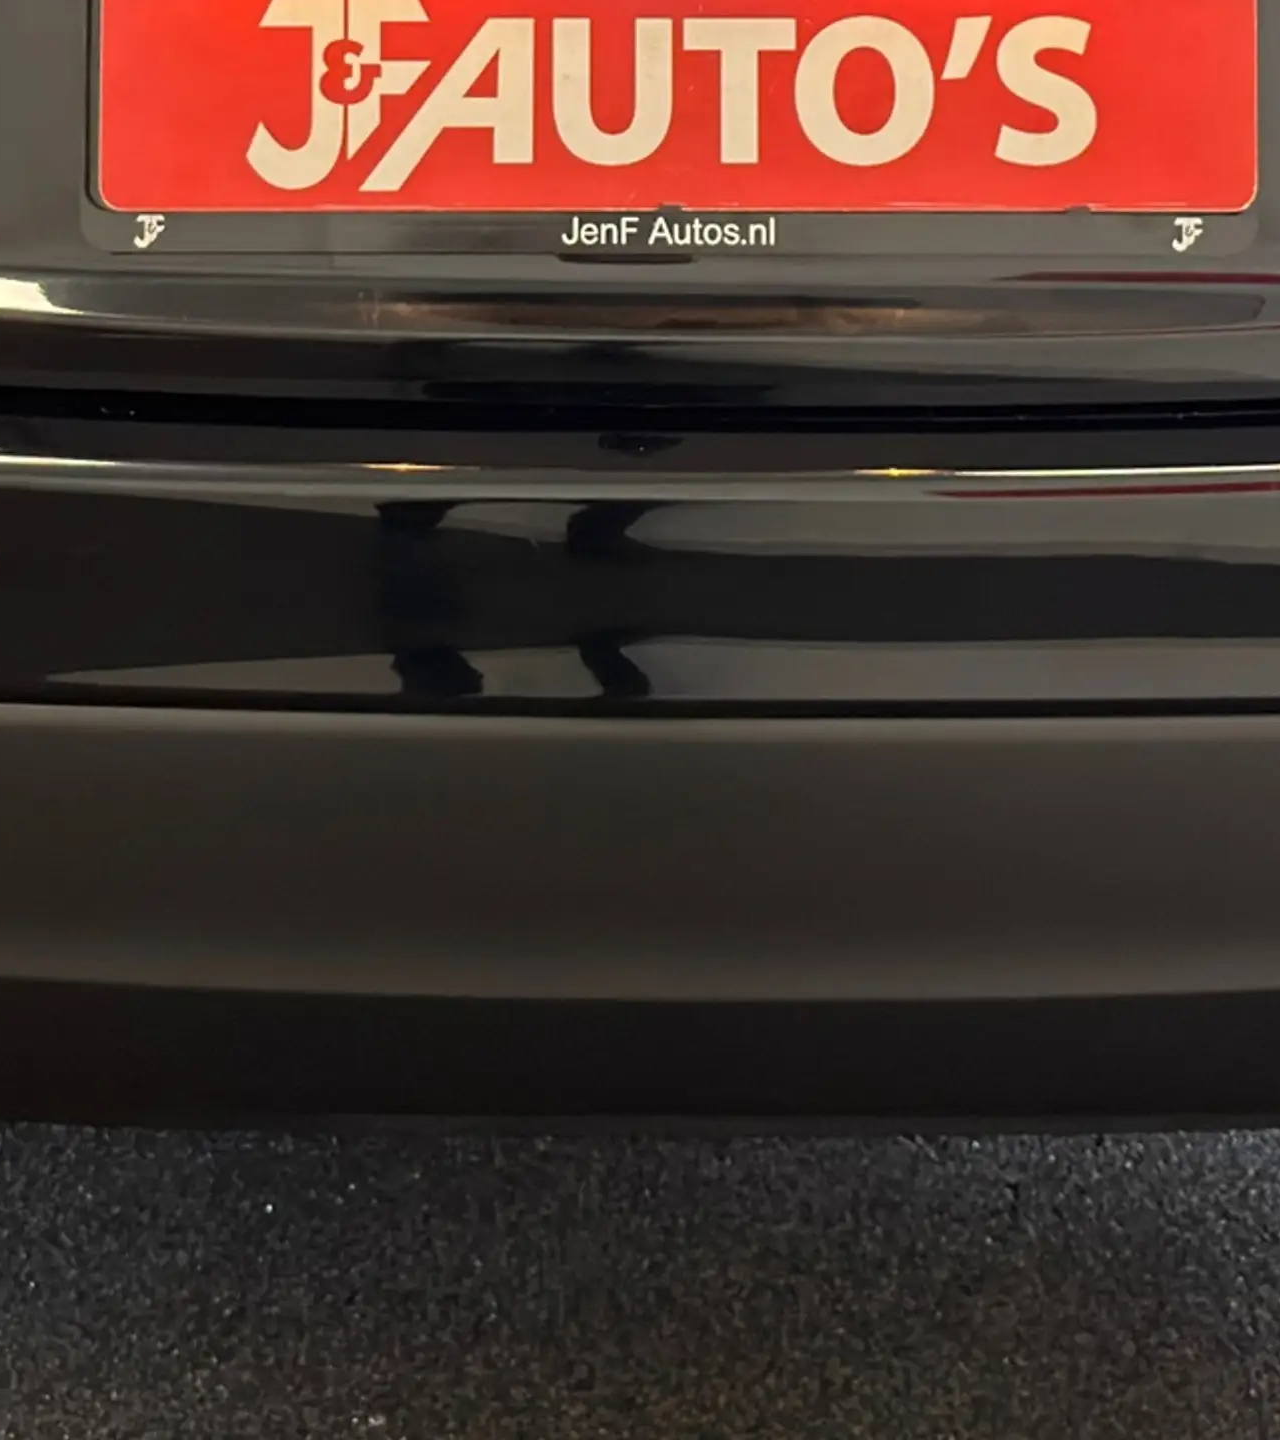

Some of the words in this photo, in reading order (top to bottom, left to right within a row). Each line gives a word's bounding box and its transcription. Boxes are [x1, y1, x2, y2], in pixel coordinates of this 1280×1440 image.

[358, 15, 1099, 192] AUTO'S
[561, 216, 639, 246] JenF
[647, 216, 776, 246] Autos.nl
